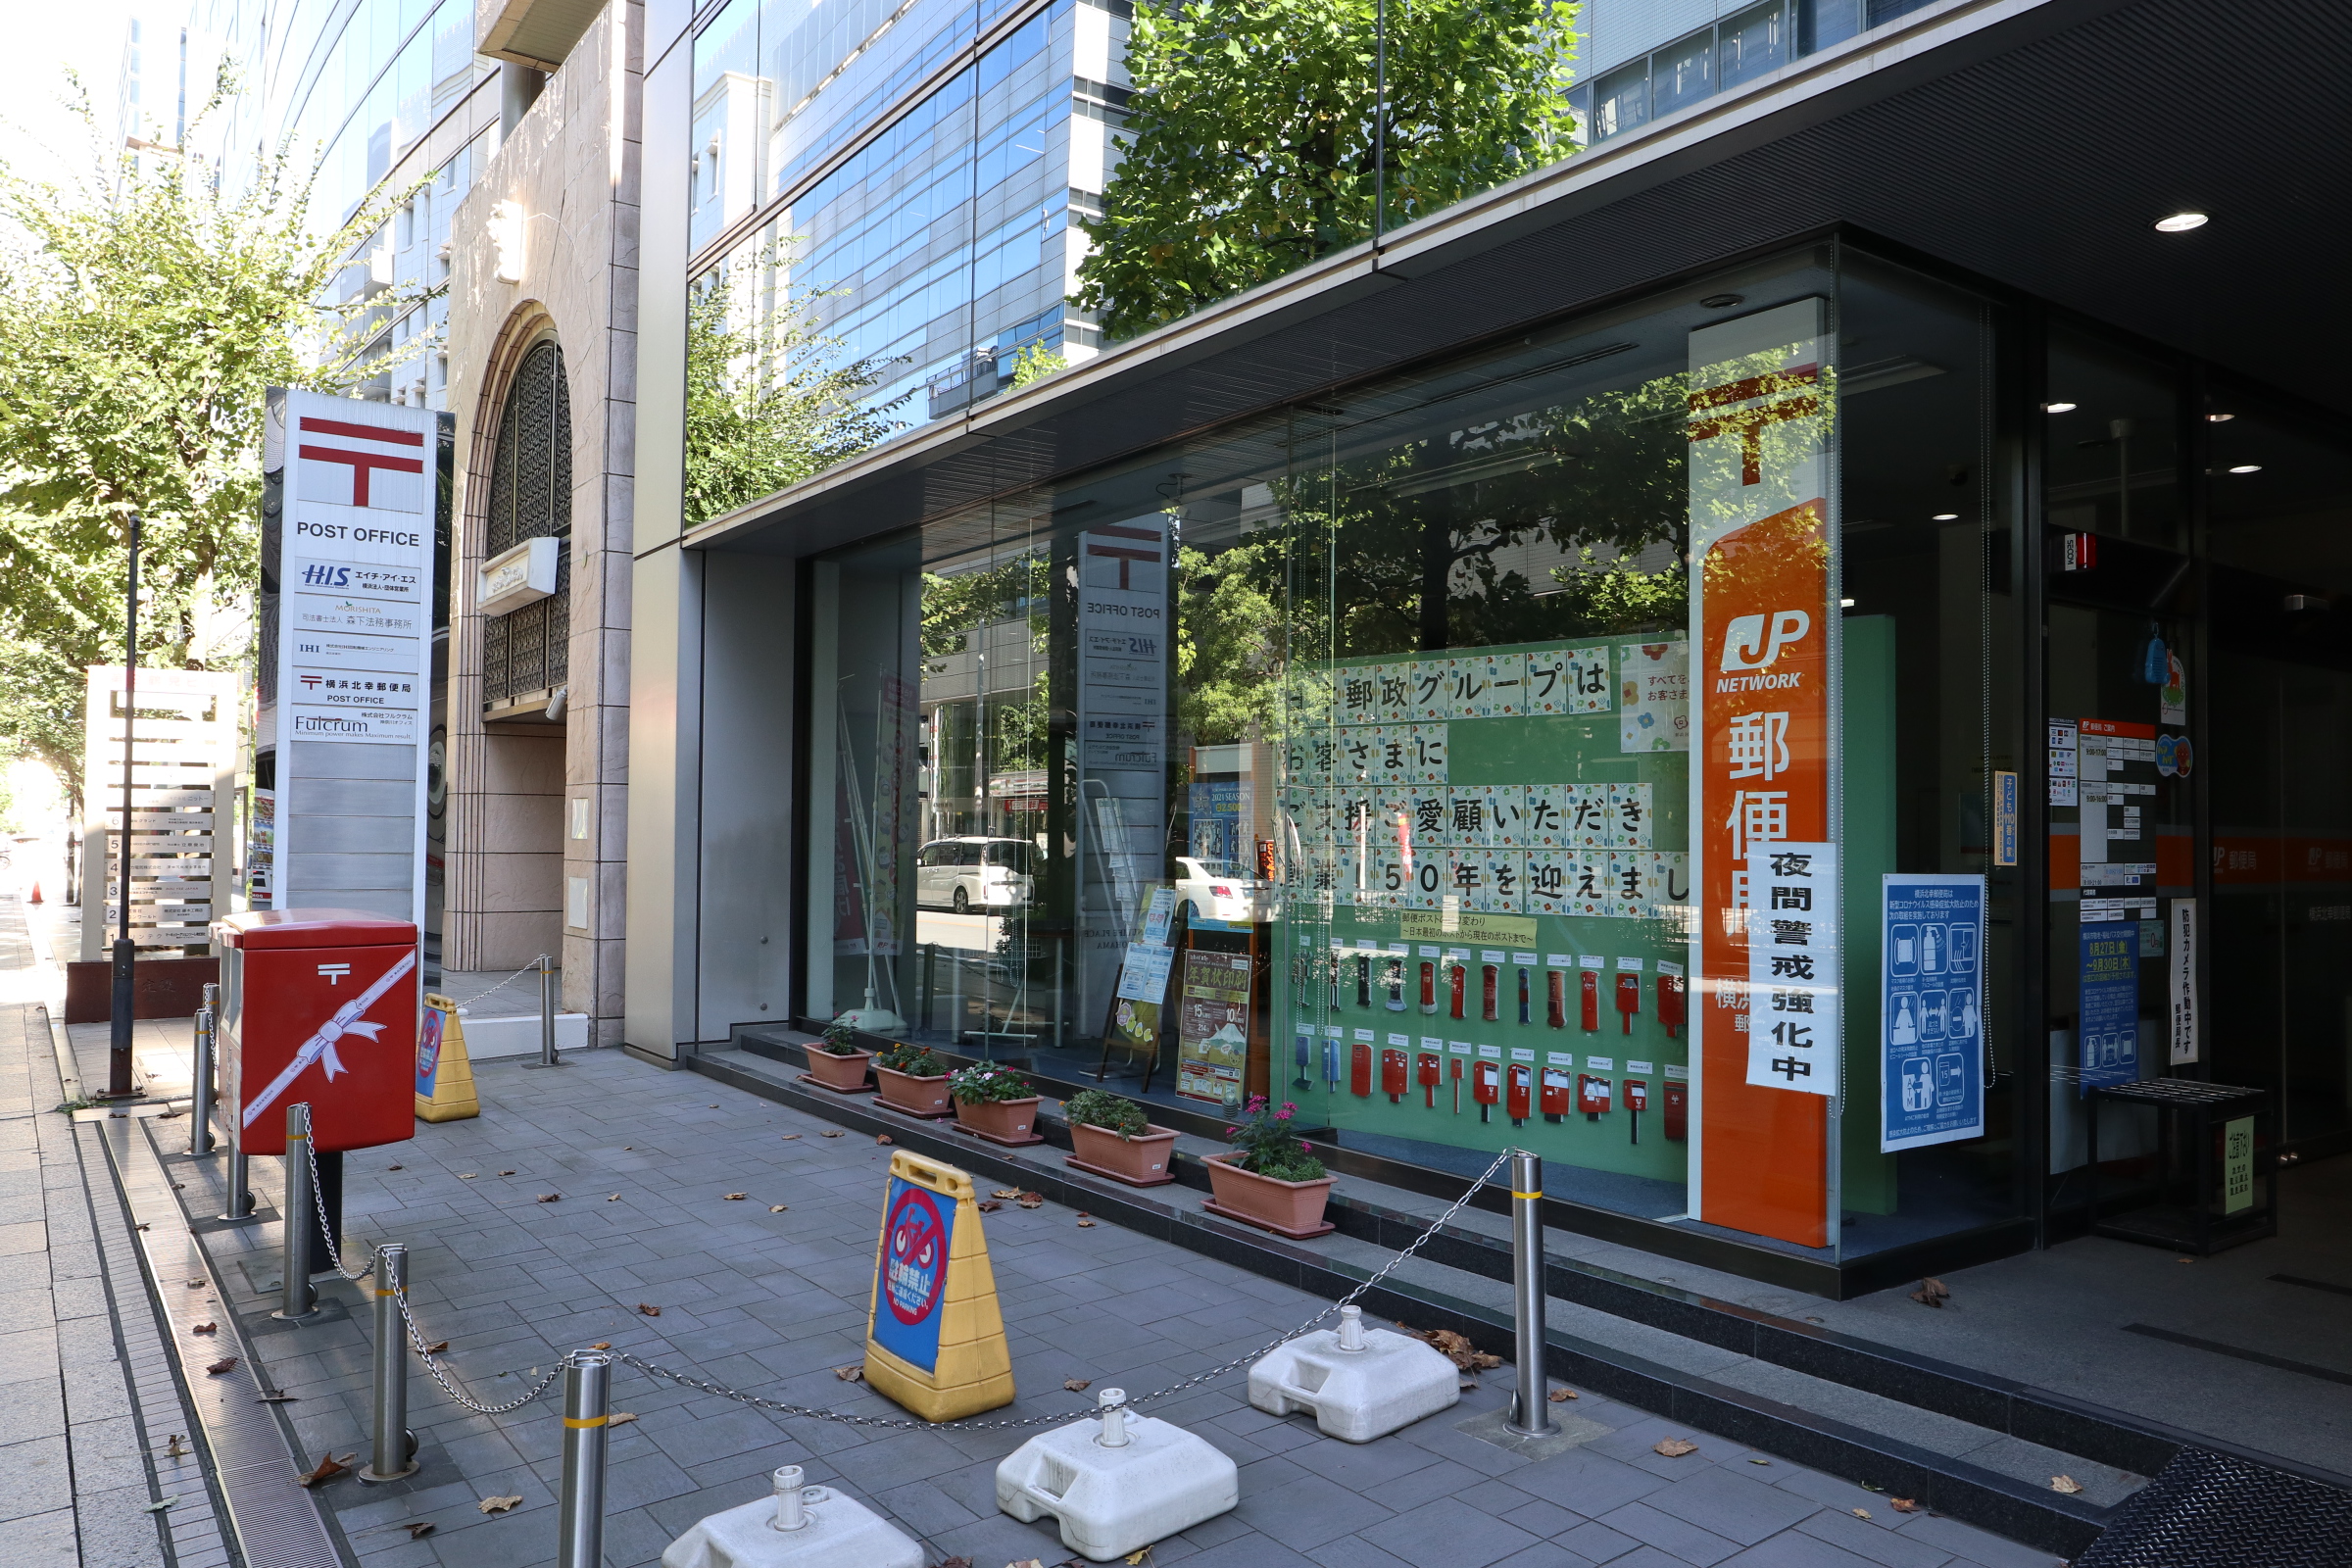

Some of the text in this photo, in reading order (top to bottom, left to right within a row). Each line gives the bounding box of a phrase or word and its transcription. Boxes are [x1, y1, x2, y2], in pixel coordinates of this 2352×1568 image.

[297, 521, 419, 547] POST OFFICE
[355, 571, 416, 584] エイチ・アイ・エス
[334, 605, 381, 614] MORISHITA
[302, 613, 412, 630] 司法書士法人 森下法務事務所
[299, 644, 319, 653] IHI
[325, 679, 412, 693] 横浜北幸郵便局
[1716, 671, 1801, 693] NETWORK
[353, 696, 384, 705] OFFICE
[295, 715, 368, 733] Fulcrum
[1285, 740, 1444, 772] お客さまに
[2085, 748, 2107, 757] 9:00-17:00
[1211, 792, 1250, 802] 2021 SEASON
[112, 816, 119, 825] 6
[111, 840, 119, 849] 5
[2229, 850, 2256, 870] 郵便局
[110, 887, 118, 896] 3
[109, 909, 117, 919] 2
[109, 933, 115, 942] 1
[1770, 853, 1815, 1081] 夜間警戒強化中
[1188, 964, 1250, 990] 年賀状印刷
[2181, 908, 2191, 1054] 防犯カメラ作動中です
[1940, 1069, 1948, 1079] 15
[889, 1258, 931, 1298] 駐輪禁止
[893, 1297, 918, 1316] NO PARKING
